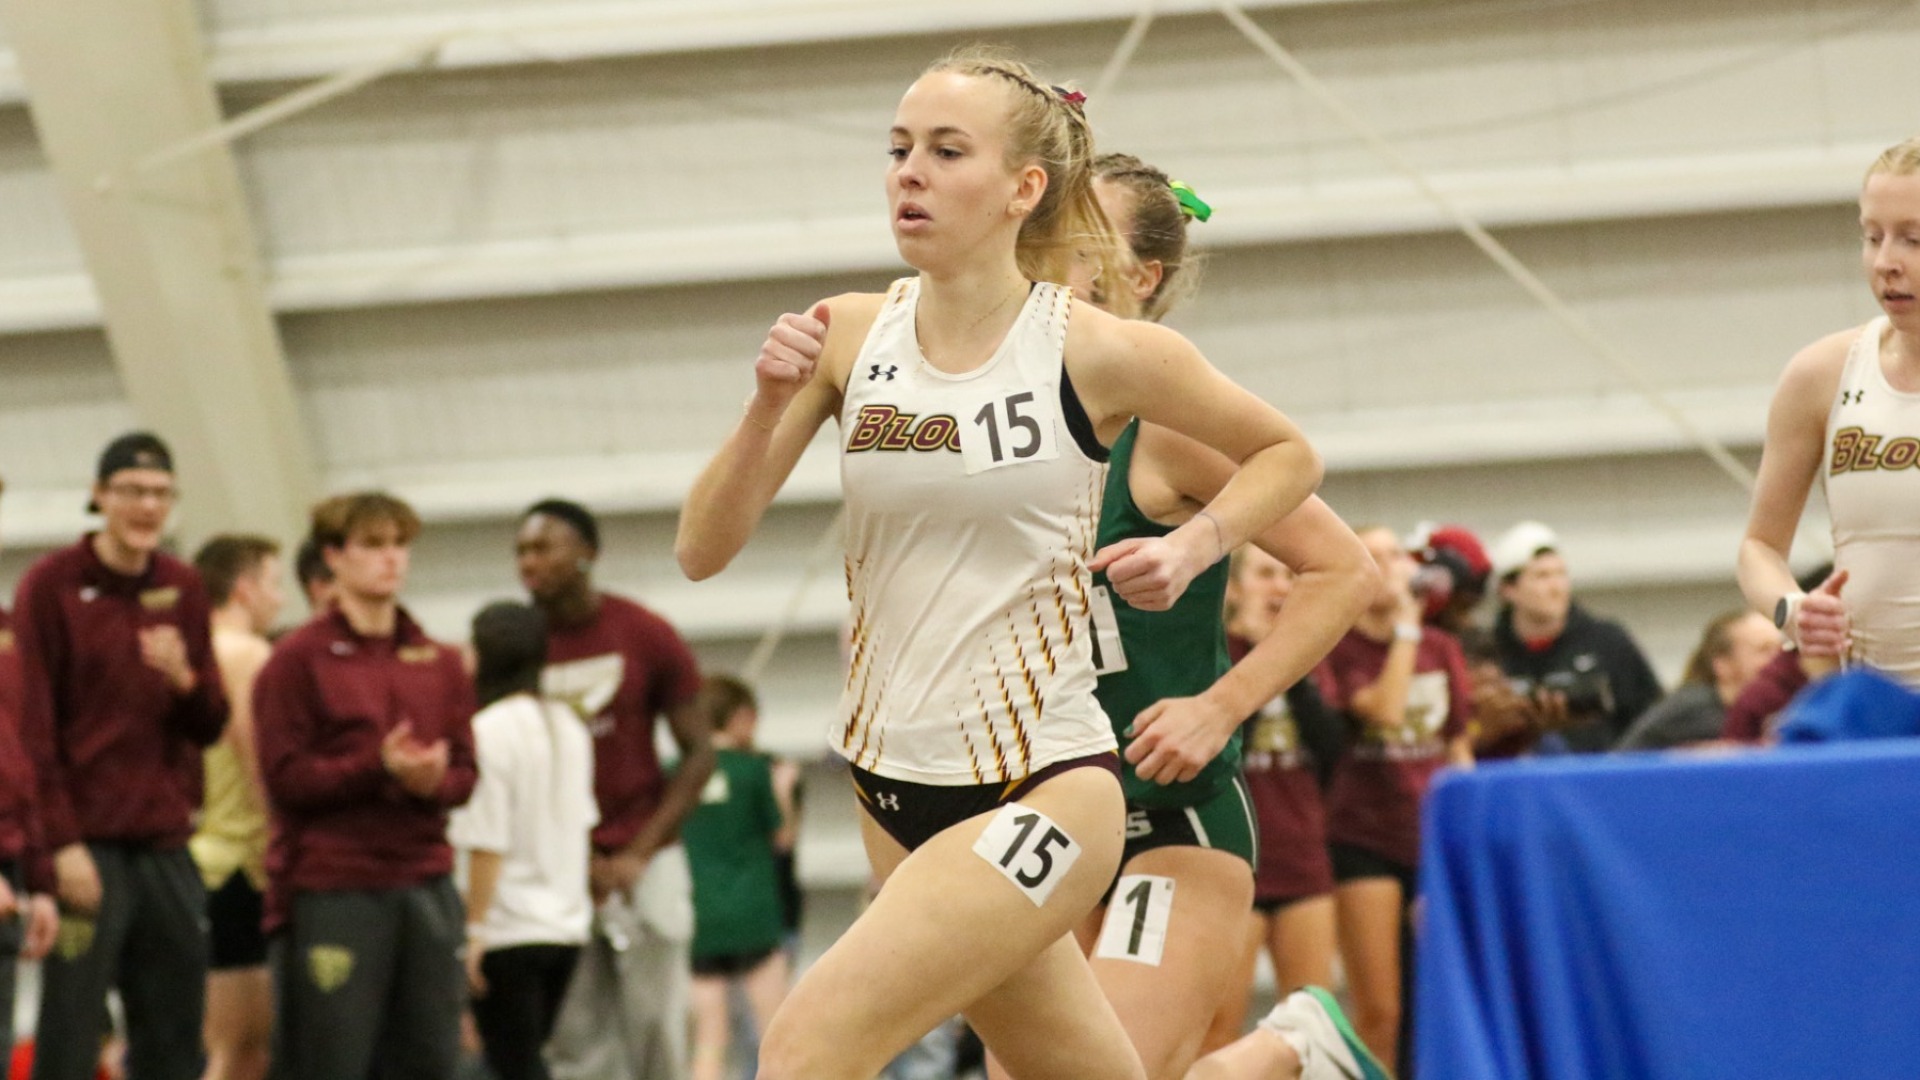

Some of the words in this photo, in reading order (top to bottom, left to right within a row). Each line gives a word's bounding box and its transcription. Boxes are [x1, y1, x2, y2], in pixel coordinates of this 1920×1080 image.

[973, 391, 1042, 463] 15
[1829, 426, 1920, 477] BLO
[998, 812, 1070, 889] 15
[1125, 880, 1152, 956] 1
